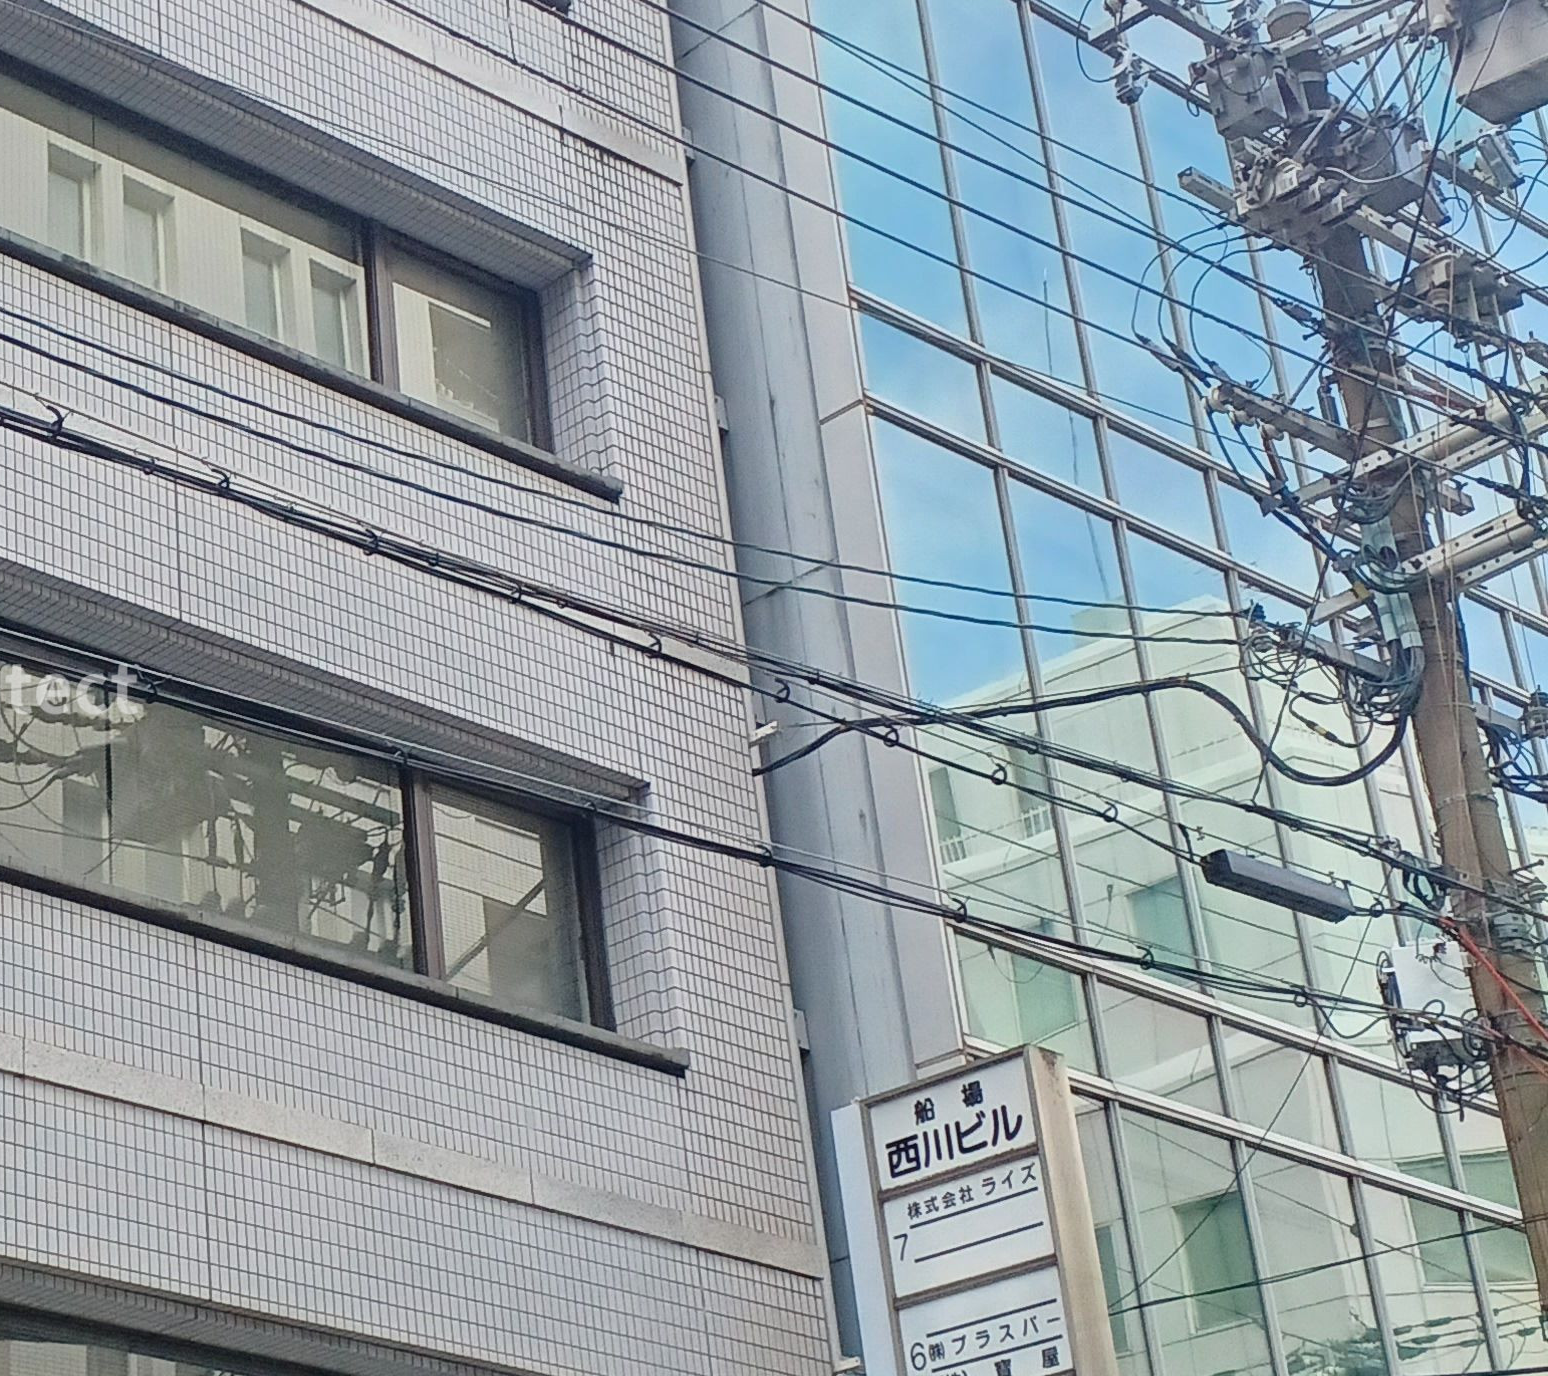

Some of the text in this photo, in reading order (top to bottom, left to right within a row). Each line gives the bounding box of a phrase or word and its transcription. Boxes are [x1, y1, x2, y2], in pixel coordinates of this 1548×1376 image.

[885, 1105, 1023, 1179] 西川ビル
[907, 1162, 1037, 1220] 株式会社 ライズ
[893, 1233, 909, 1261] 7
[910, 1342, 927, 1371] 6
